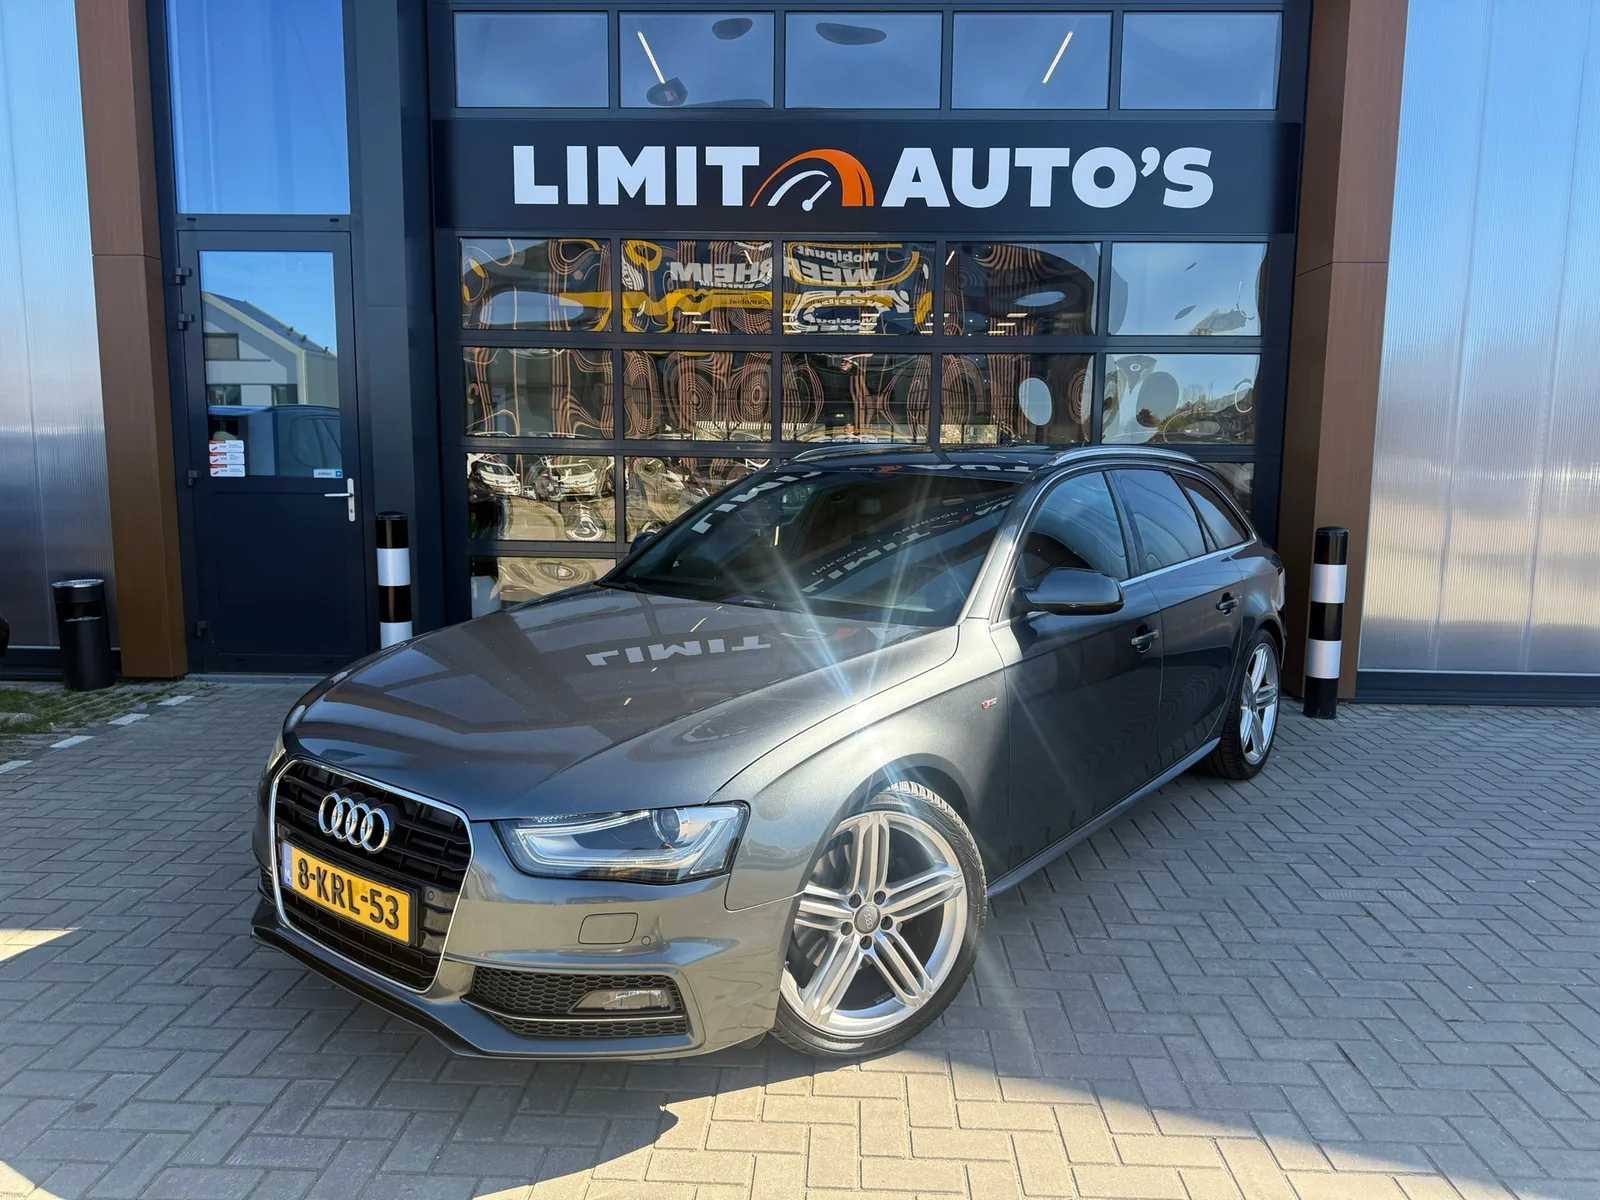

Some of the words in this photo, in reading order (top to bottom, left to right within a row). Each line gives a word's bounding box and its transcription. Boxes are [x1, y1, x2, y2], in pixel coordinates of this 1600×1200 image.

[513, 145, 760, 206] LIMIT
[881, 147, 1214, 208] AUTO'S
[297, 857, 399, 930] 8-KRL-53
